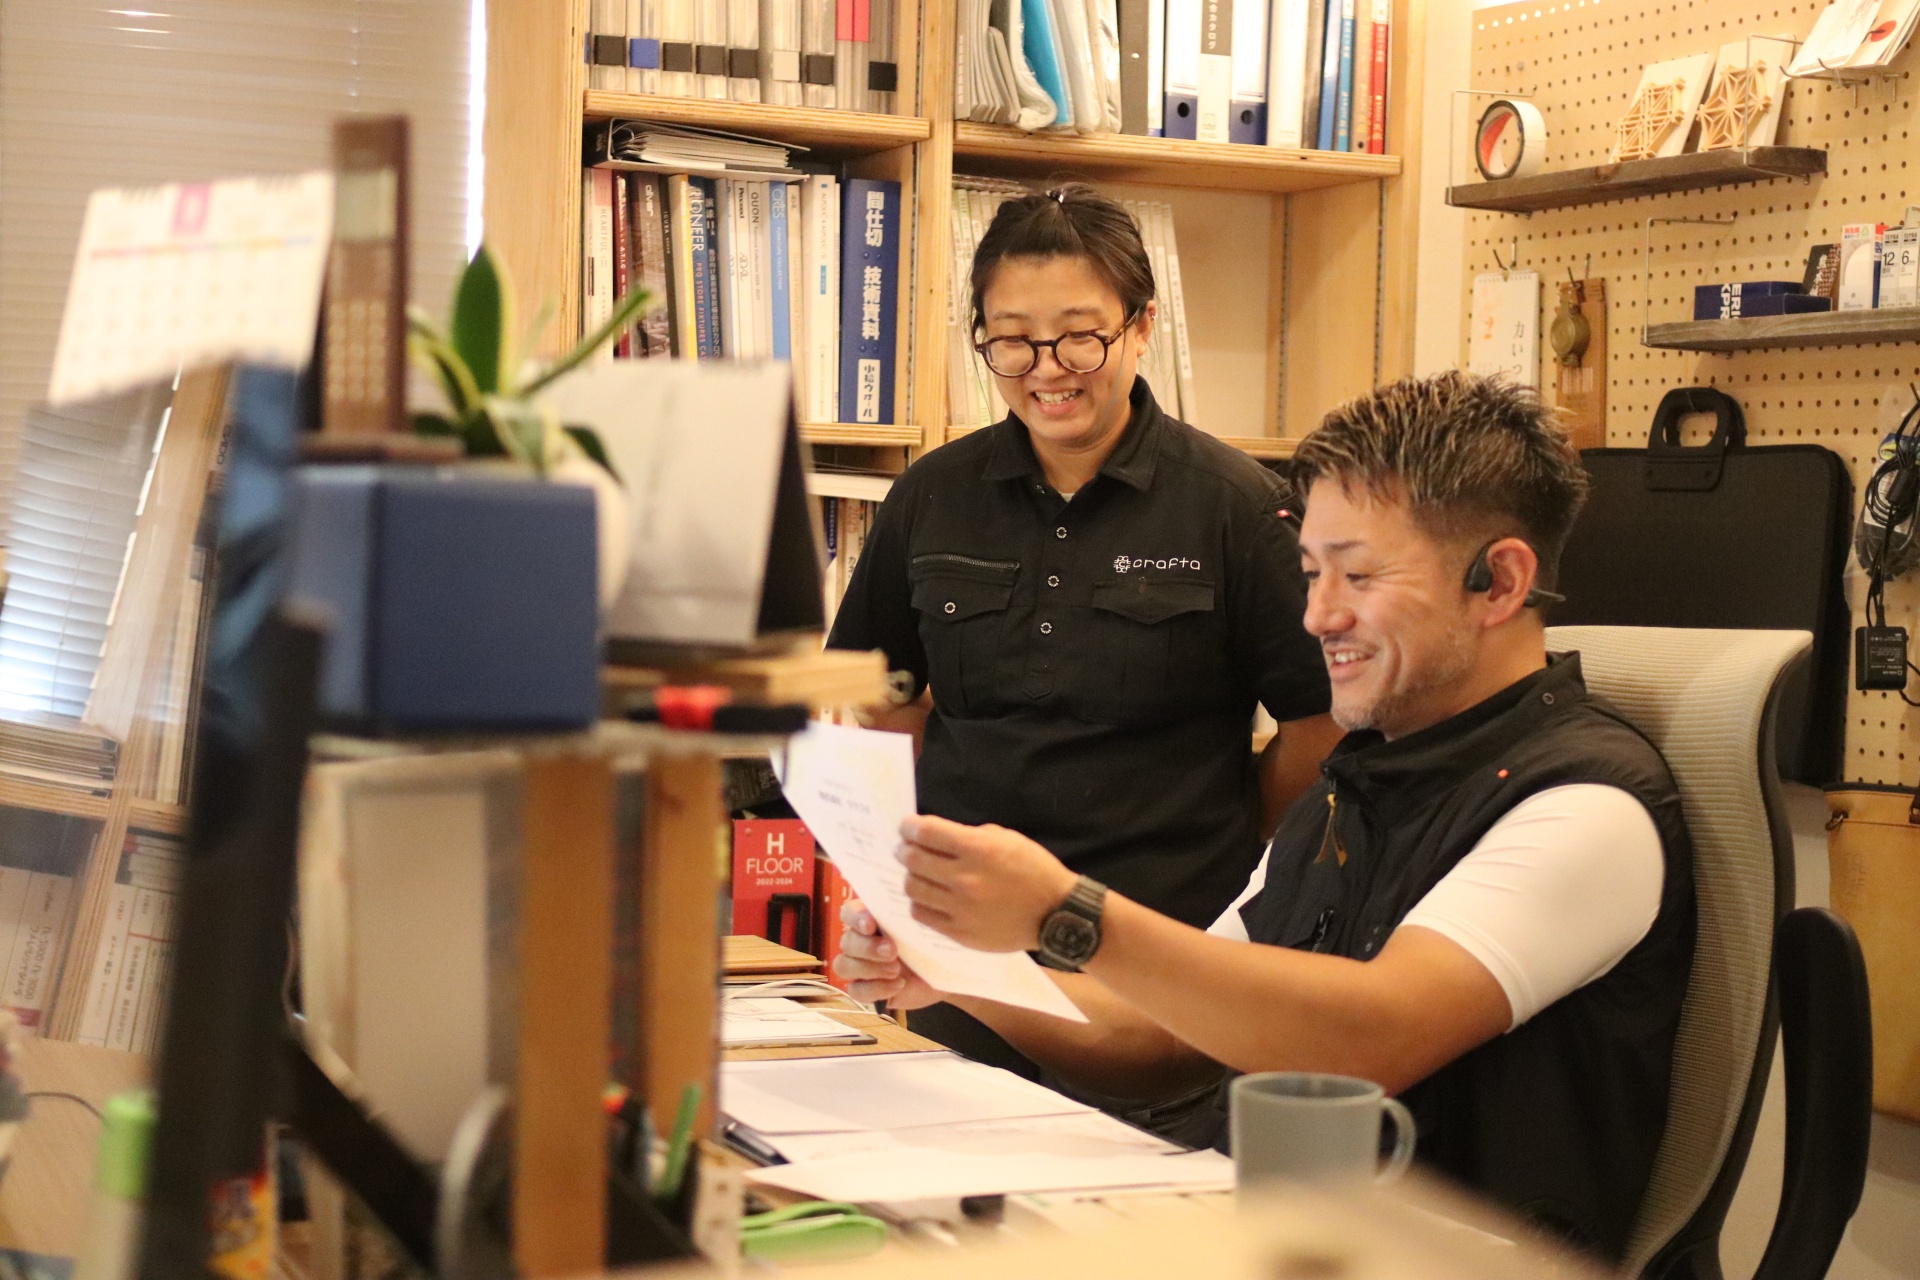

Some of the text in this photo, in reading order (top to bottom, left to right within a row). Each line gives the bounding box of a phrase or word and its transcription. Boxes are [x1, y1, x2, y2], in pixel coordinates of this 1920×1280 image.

[1208, 0, 1218, 50] 合カタログ
[751, 192, 759, 223] QUON
[865, 191, 884, 247] 間仕切
[1883, 252, 1895, 266] 12
[1902, 251, 1909, 265] 6
[696, 280, 704, 304] STORE
[862, 266, 882, 341] 技術資料
[1731, 284, 1742, 318] ERI
[698, 307, 706, 344] FIXTURES
[1132, 557, 1200, 570] crafta
[767, 832, 784, 855] H
[746, 857, 804, 874] FLOOR
